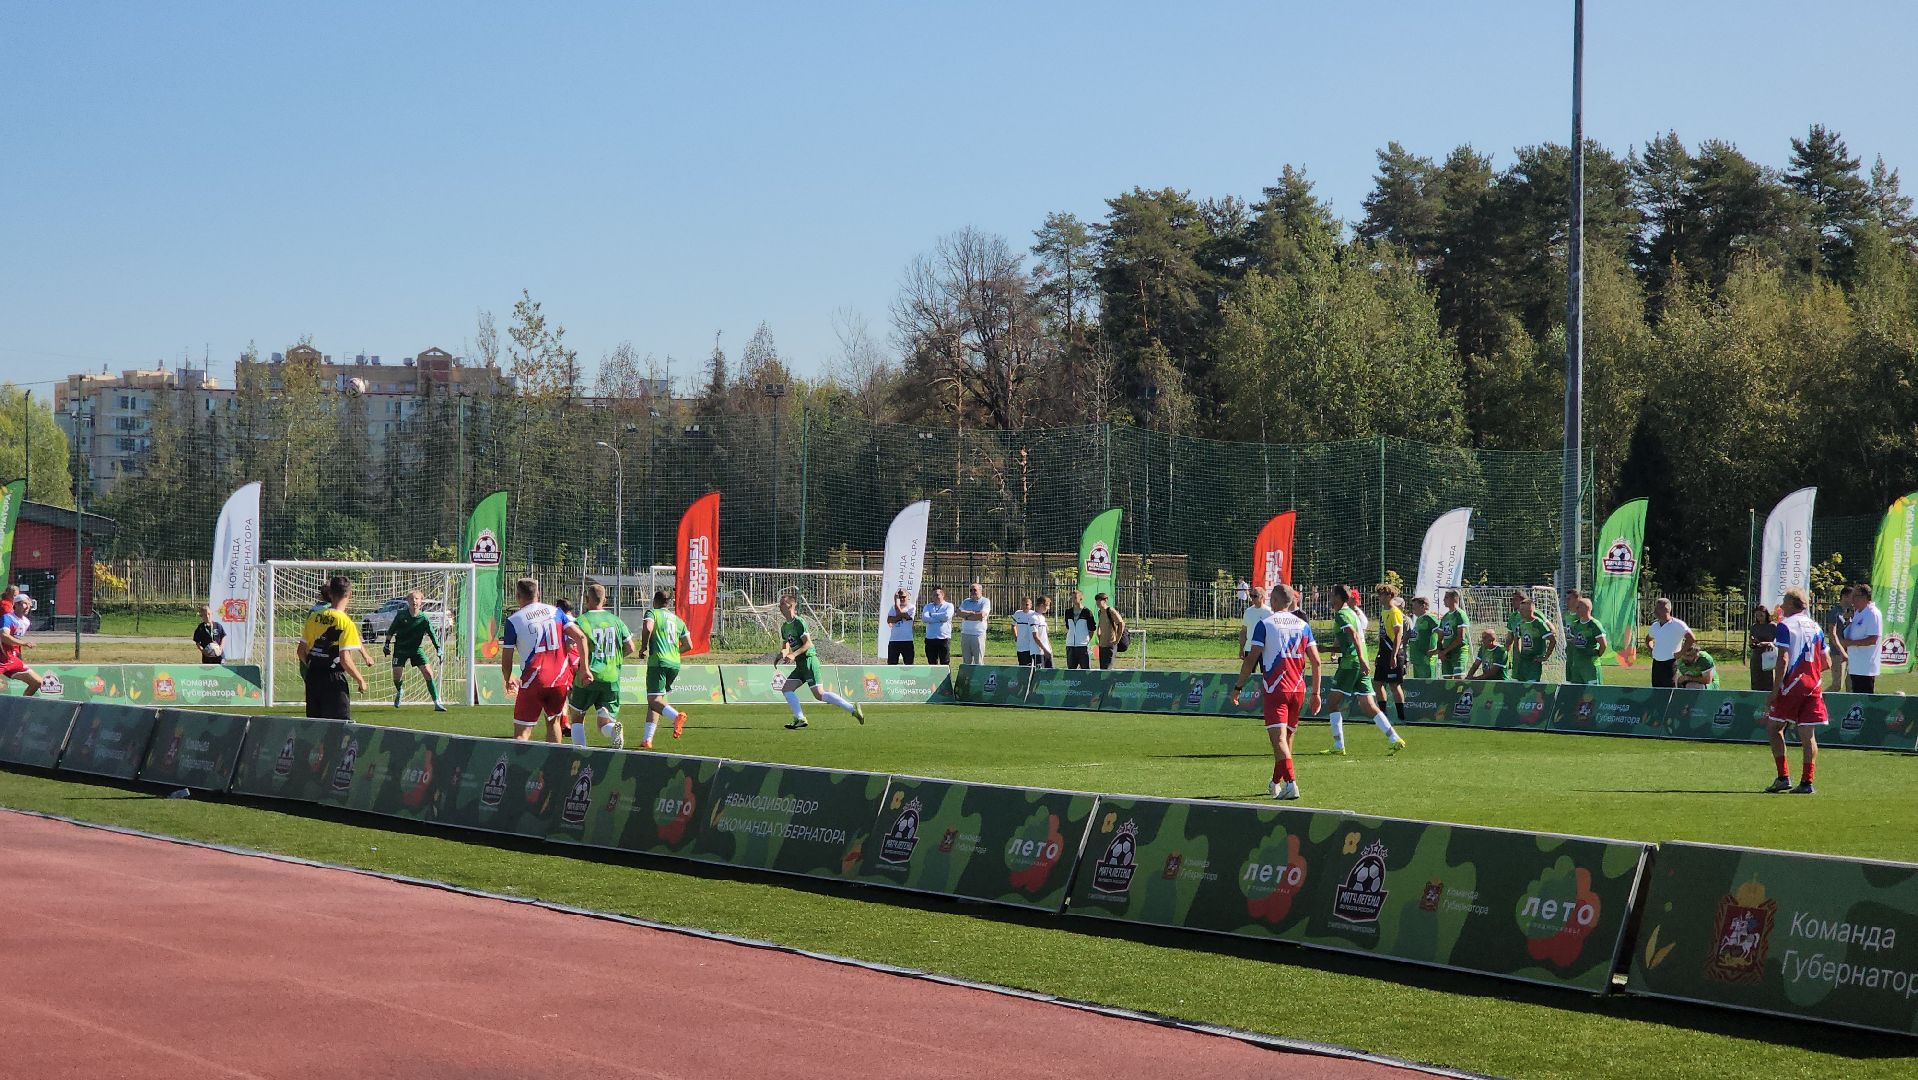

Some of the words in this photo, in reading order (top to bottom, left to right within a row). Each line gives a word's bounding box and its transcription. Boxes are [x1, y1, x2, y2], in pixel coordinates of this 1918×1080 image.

[229, 538, 240, 589] КОМАНДА
[242, 518, 252, 589] ГУБЕРНАТОРА
[1791, 530, 1801, 586] бернатора
[1446, 545, 1457, 586] РНАТОРА
[1778, 551, 1788, 597] Команда
[528, 618, 559, 653] 20
[180, 679, 218, 687] Команда
[182, 688, 236, 697] Губернатора
[1599, 702, 1630, 712] Команда
[1595, 712, 1641, 725] Губернатора
[402, 768, 431, 783] лето
[655, 797, 692, 816] лето
[724, 791, 819, 815] #ВЫХОДИВОДВОР
[717, 817, 846, 845] #КОМАНДАГУБЕРНАТОРА
[1008, 838, 1058, 859] лето
[1099, 866, 1112, 877] МАТЧ
[1112, 867, 1131, 879] ЛЕГЕНД
[1243, 862, 1302, 886] лето
[1340, 891, 1358, 904] МАТЧ
[1357, 893, 1380, 907] ЛЕГЕНД
[1446, 888, 1479, 900] Команда
[1443, 900, 1489, 915] Губернатора
[1521, 896, 1594, 926] лето
[1790, 911, 1895, 951] Команда
